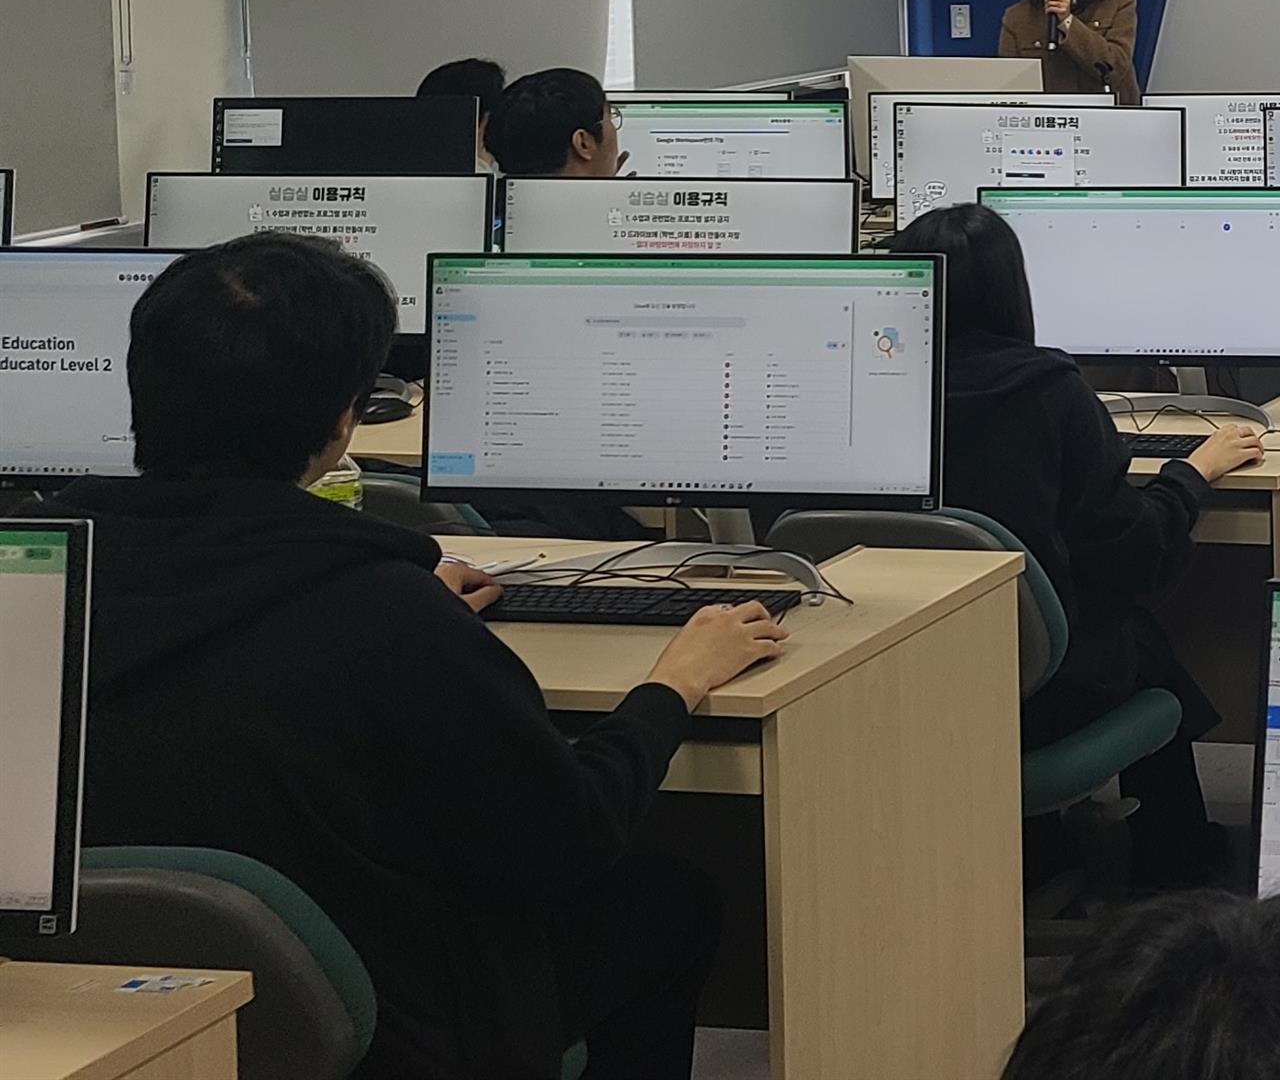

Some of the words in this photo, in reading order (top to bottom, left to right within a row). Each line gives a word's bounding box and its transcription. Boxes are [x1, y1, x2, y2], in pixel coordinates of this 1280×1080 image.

[1034, 116, 1079, 130] 이용규칙
[312, 187, 366, 202] 이용규칙
[673, 191, 728, 207] 이용규칙
[2, 336, 75, 351] Education
[60, 357, 99, 371] Level
[102, 359, 112, 372] 2
